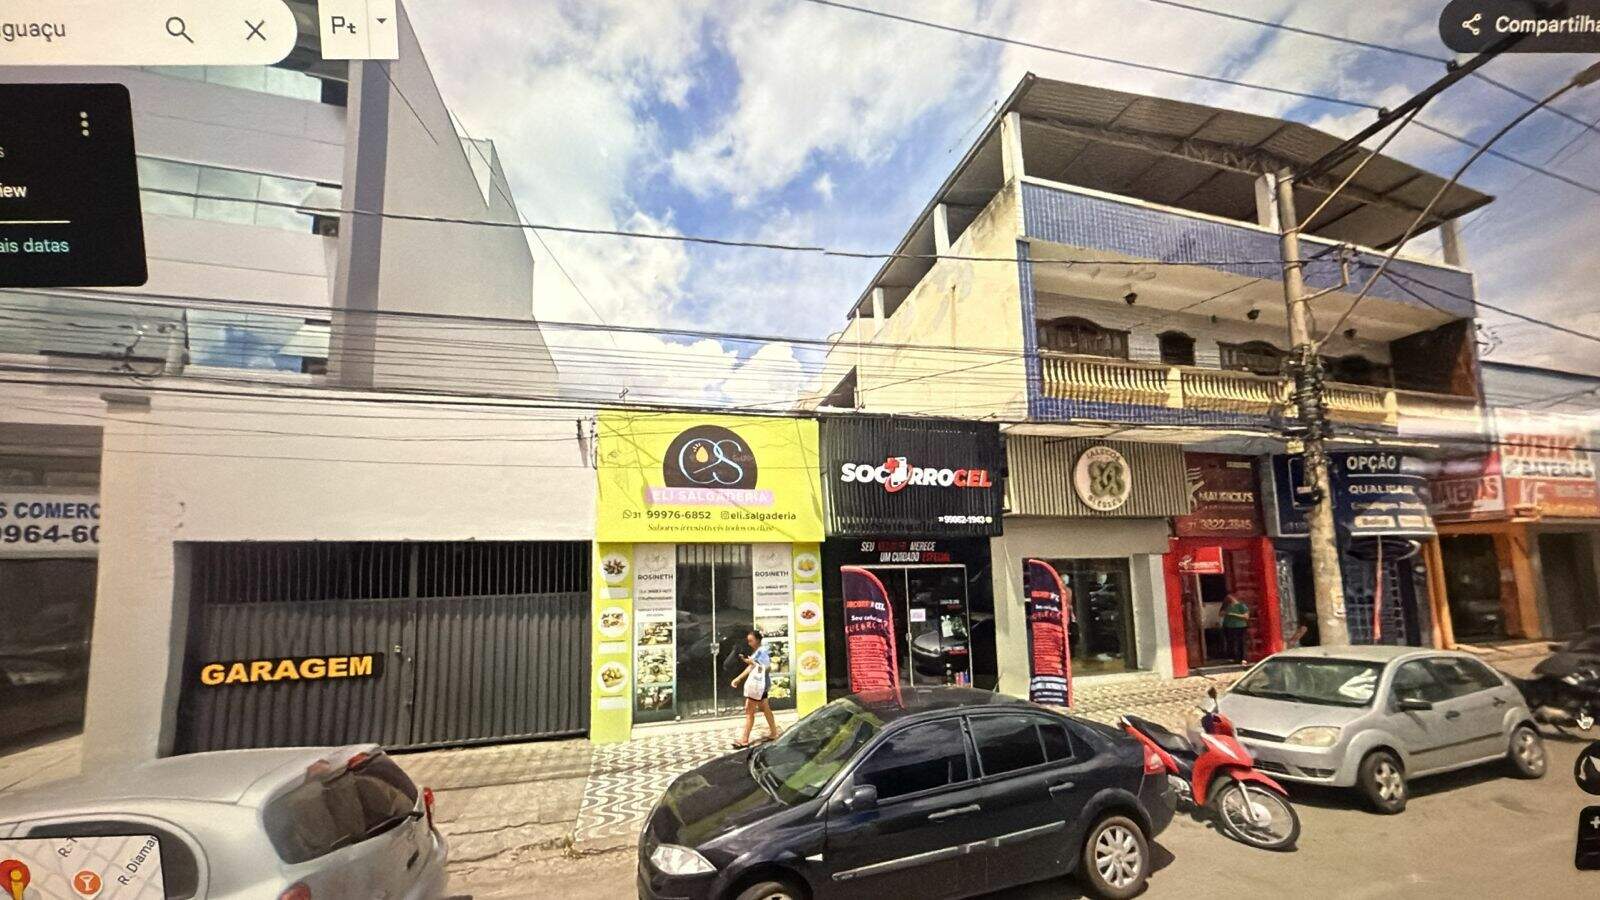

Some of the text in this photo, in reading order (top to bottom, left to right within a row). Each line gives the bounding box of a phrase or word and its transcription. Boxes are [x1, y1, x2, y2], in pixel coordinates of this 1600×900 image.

[2, 22, 66, 42] guaçu
[23, 237, 70, 253] datas
[1346, 452, 1397, 473] OPÇÃO
[632, 511, 642, 519] 31
[646, 510, 712, 520] 99976-6852
[860, 541, 876, 552] SEU
[200, 655, 373, 686] GARAGEM
